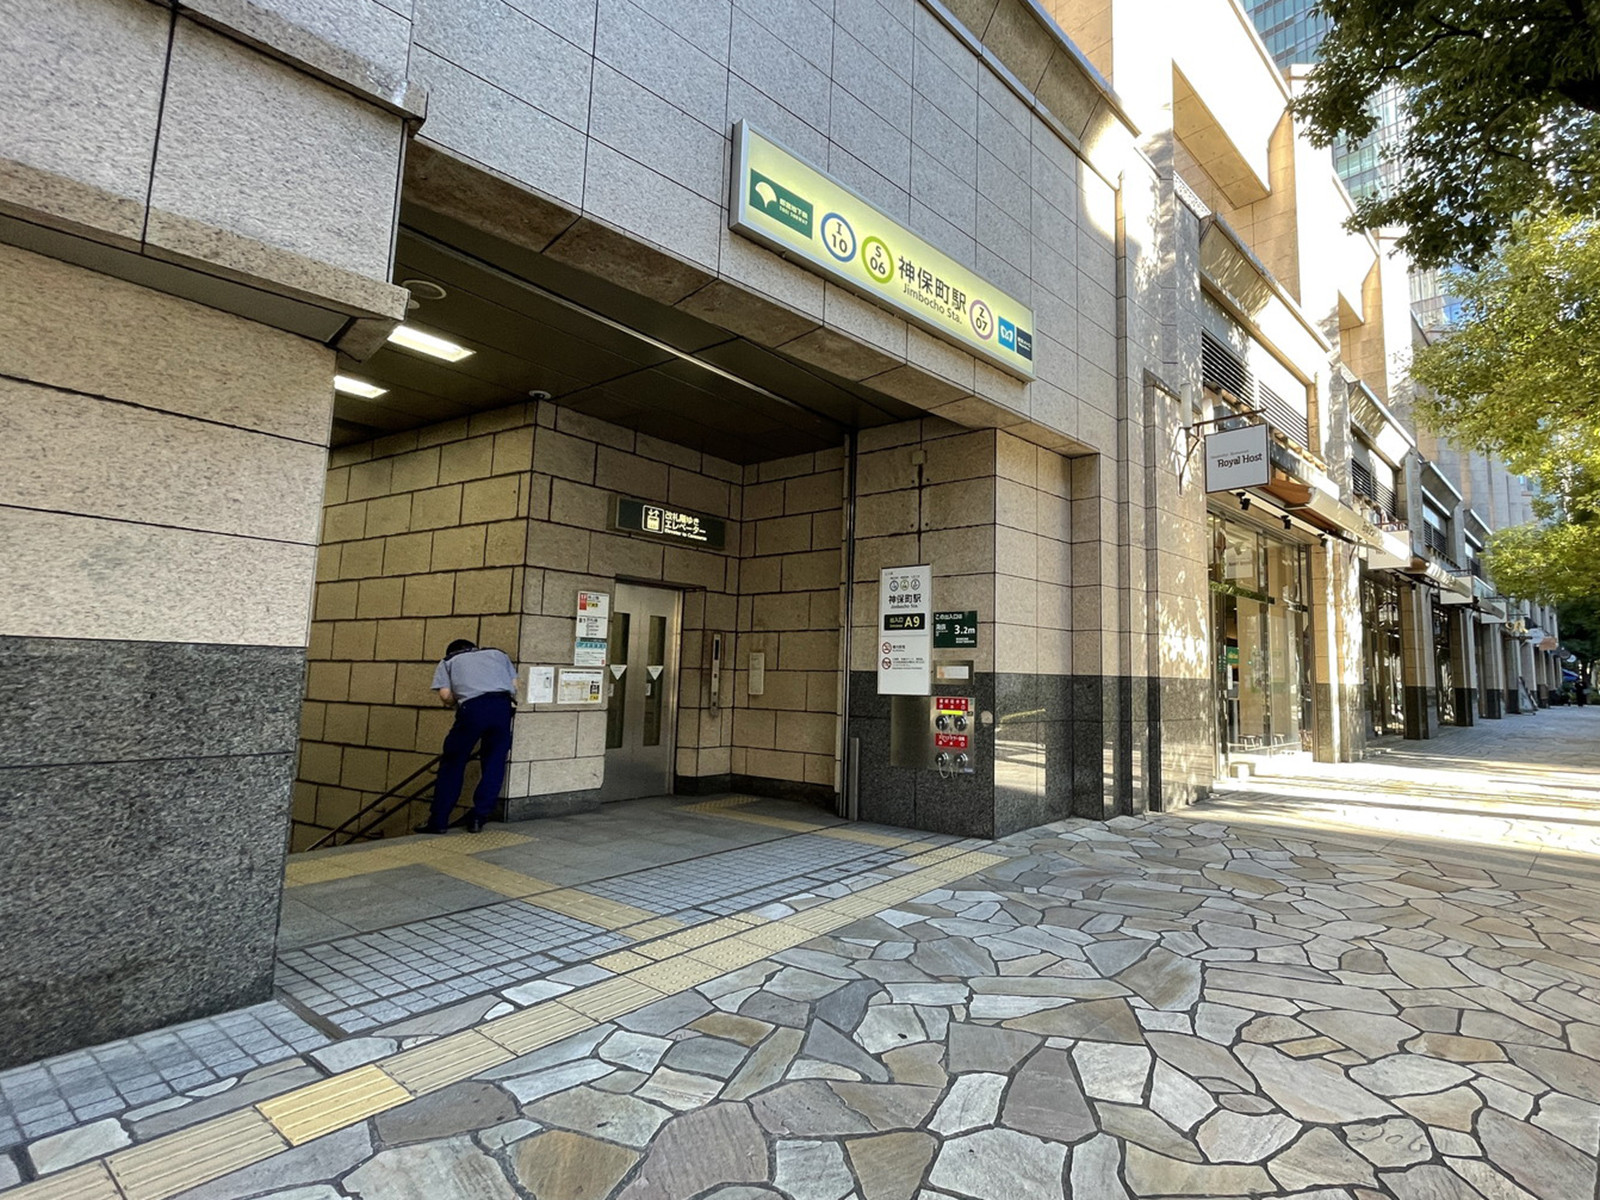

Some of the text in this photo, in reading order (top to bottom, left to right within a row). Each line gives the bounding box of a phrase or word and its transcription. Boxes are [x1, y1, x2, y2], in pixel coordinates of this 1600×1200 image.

[836, 221, 843, 236] I
[831, 233, 848, 254] 10
[875, 245, 882, 258] S
[869, 256, 886, 275] 06
[898, 255, 967, 315] 神保町駅
[903, 283, 963, 325] Jimbocho Sta.
[979, 306, 985, 319] Z
[975, 317, 988, 332] 07
[1218, 456, 1241, 468] Royal
[1242, 453, 1262, 464] Host
[664, 520, 707, 535] エレベーター
[888, 593, 922, 605] 神保町駅
[904, 616, 921, 628] A9
[954, 624, 976, 635] 3.2m
